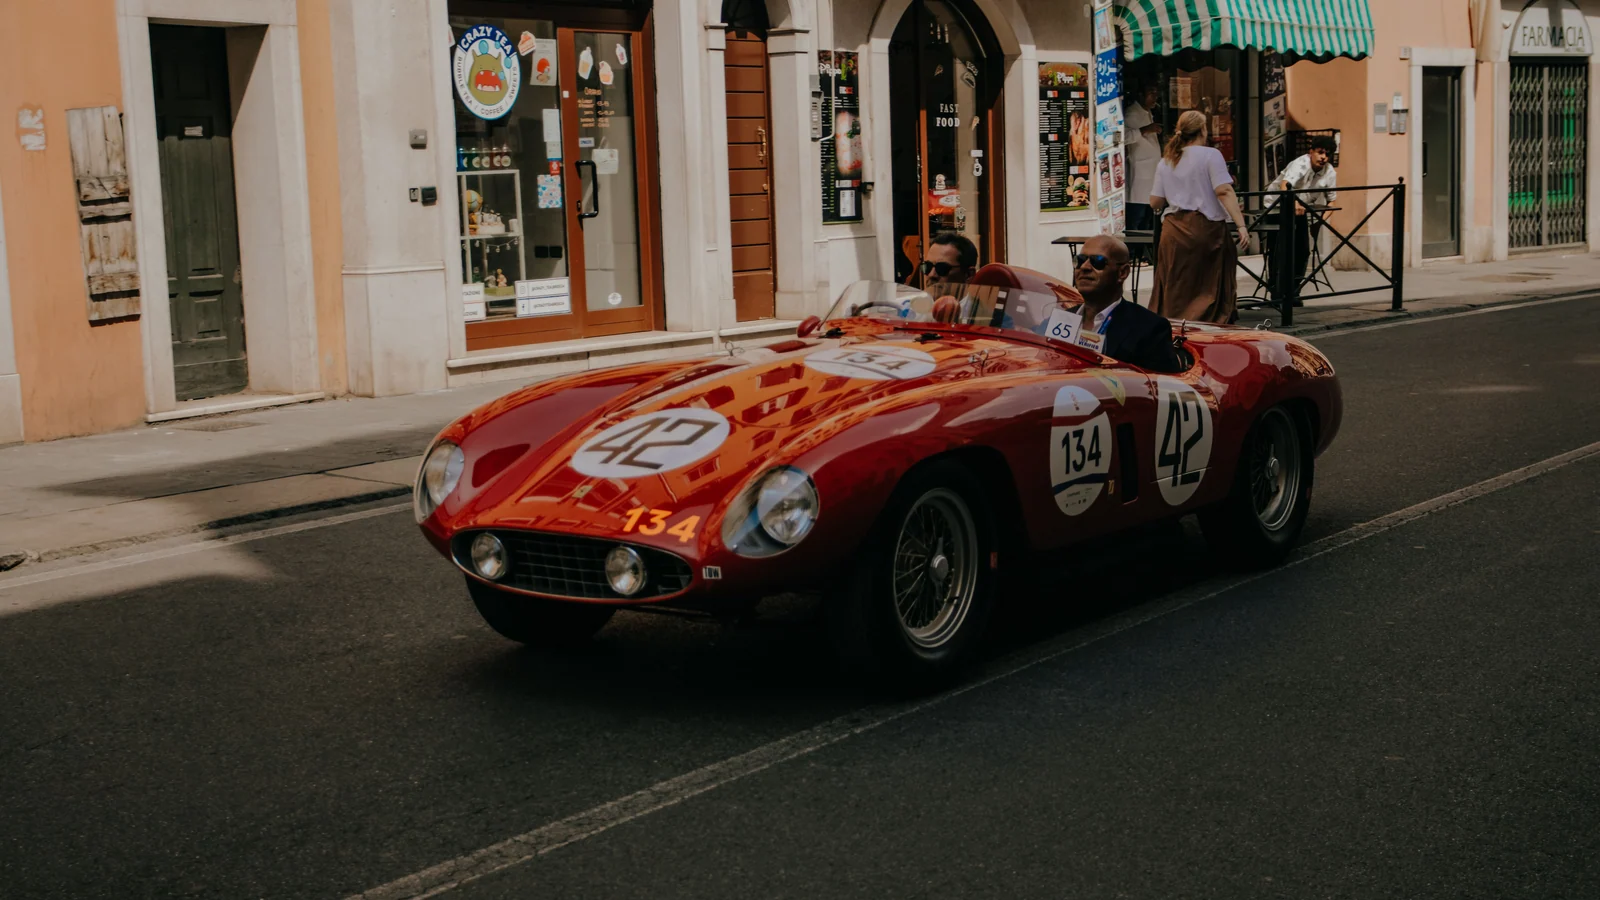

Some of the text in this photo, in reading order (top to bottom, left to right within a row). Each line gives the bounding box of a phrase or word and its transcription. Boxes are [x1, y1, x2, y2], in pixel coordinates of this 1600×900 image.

[461, 26, 493, 49] CRAZY
[495, 30, 512, 55] TEA
[1522, 26, 1585, 47] FARMACIA
[457, 56, 517, 116] BUBBLE TEA COFFEE SWEETS
[936, 117, 960, 127] FOOD
[939, 103, 960, 113] FAST
[1052, 322, 1072, 338] 65
[833, 351, 901, 370] 134
[584, 417, 721, 469] 42
[1062, 425, 1101, 474] 134
[1158, 391, 1203, 487] 42
[623, 507, 700, 543] 134
